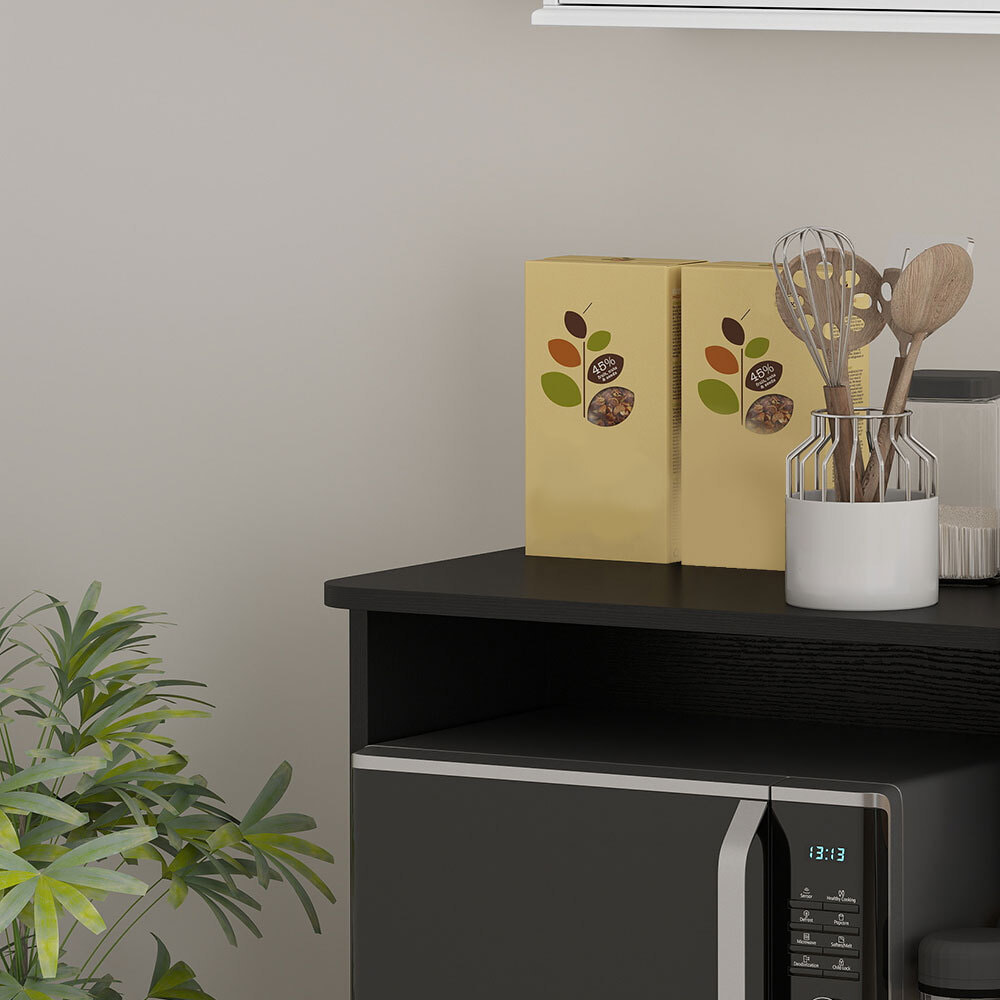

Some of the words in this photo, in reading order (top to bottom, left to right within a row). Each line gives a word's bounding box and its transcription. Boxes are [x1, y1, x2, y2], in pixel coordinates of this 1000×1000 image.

[592, 356, 616, 375] 45%
[750, 363, 775, 382] 45%
[809, 845, 846, 862] 13:13
